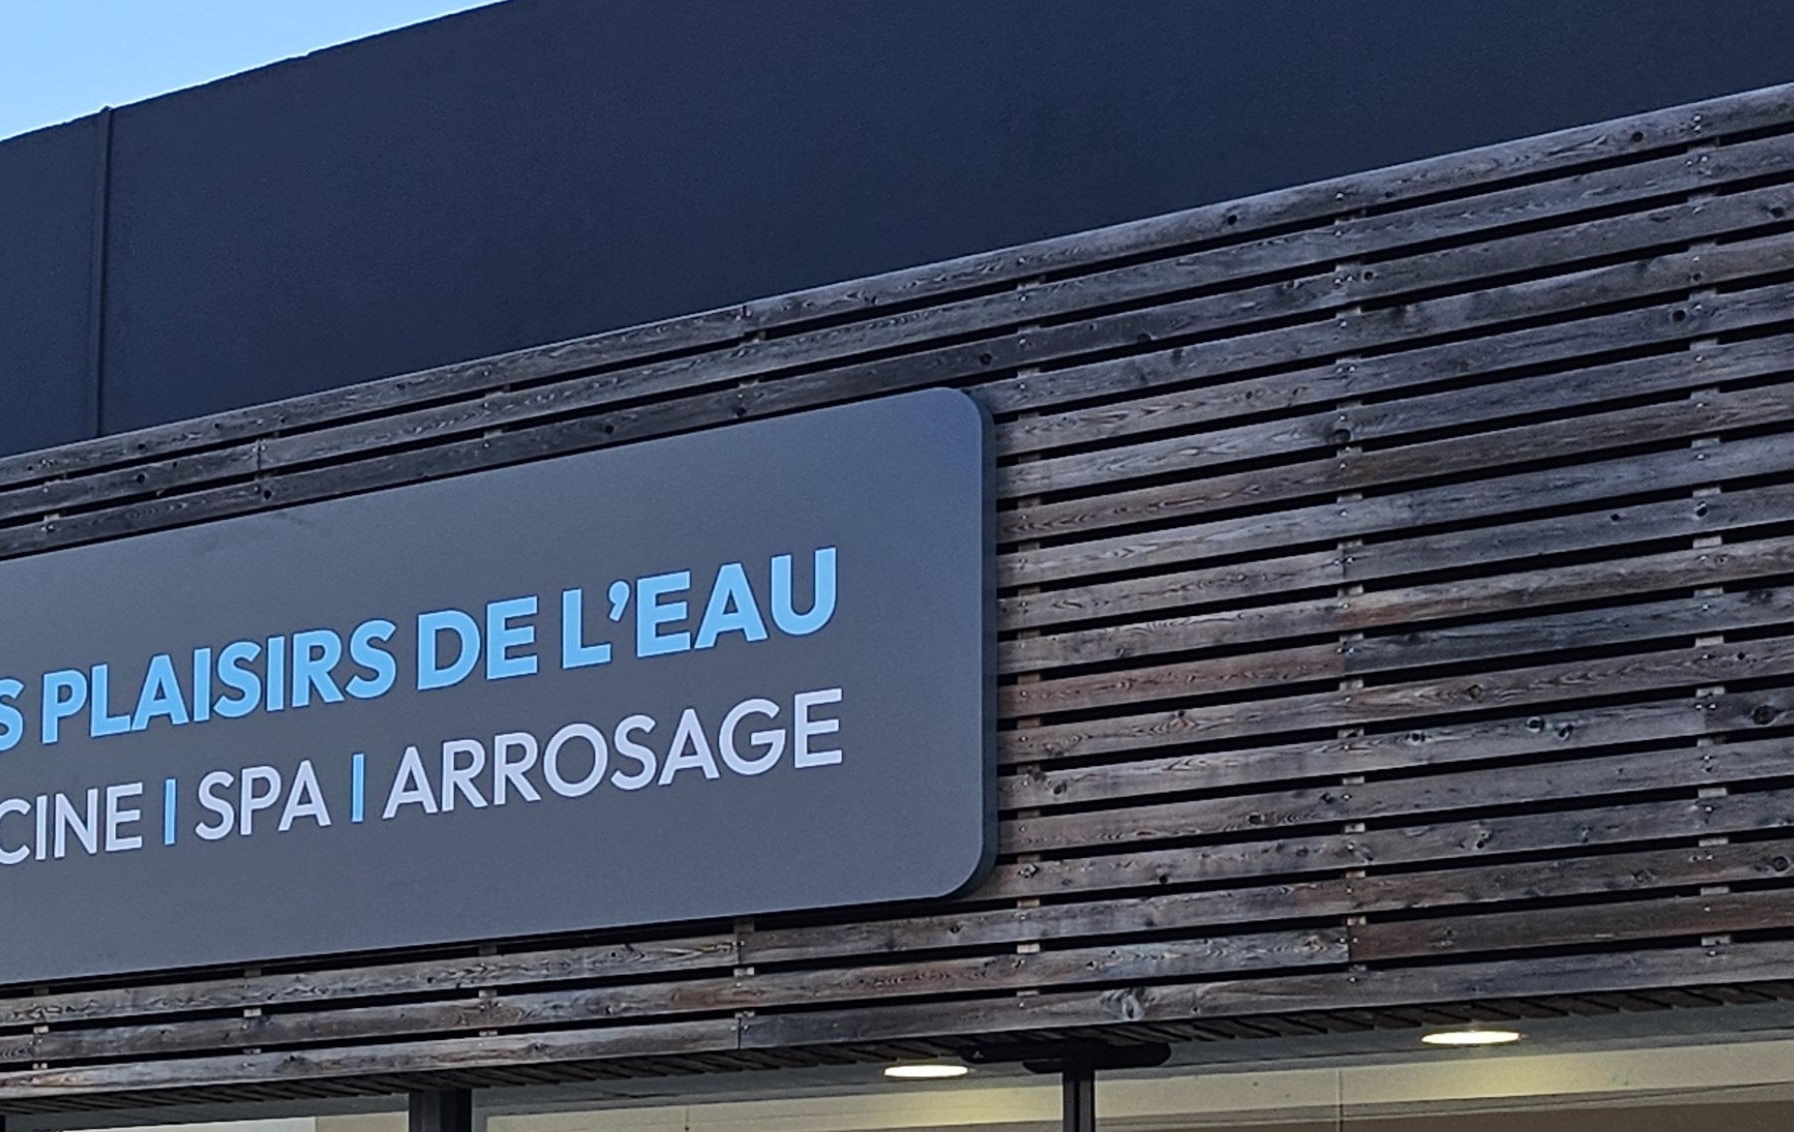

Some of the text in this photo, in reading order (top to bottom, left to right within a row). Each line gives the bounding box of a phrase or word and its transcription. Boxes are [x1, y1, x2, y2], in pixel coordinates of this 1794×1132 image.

[42, 619, 397, 744] PLAISIRS
[417, 595, 538, 691] DE
[562, 547, 837, 670] L'EAU
[195, 760, 332, 841] SPA
[382, 688, 843, 820] ARROSAGE
